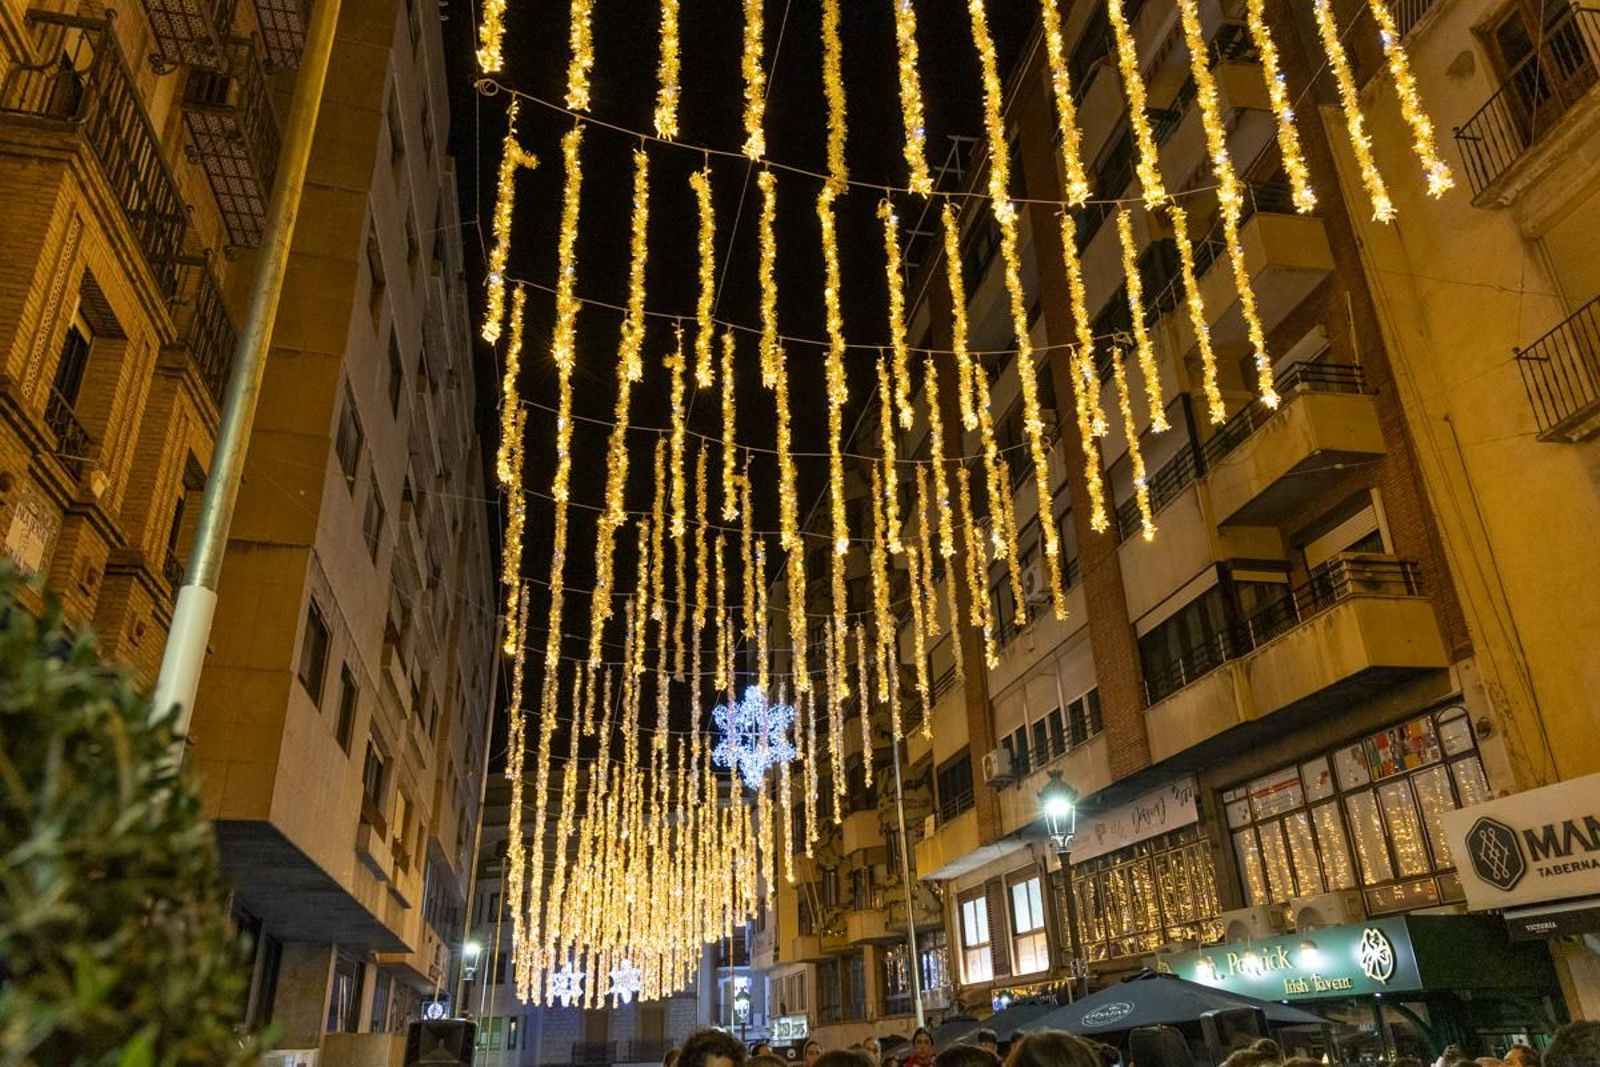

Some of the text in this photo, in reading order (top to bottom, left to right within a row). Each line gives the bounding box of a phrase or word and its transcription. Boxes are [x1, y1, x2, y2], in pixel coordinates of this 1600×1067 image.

[1537, 858, 1600, 878] TABERNA
[1226, 945, 1293, 976] Paick
[1284, 976, 1309, 994] Irish
